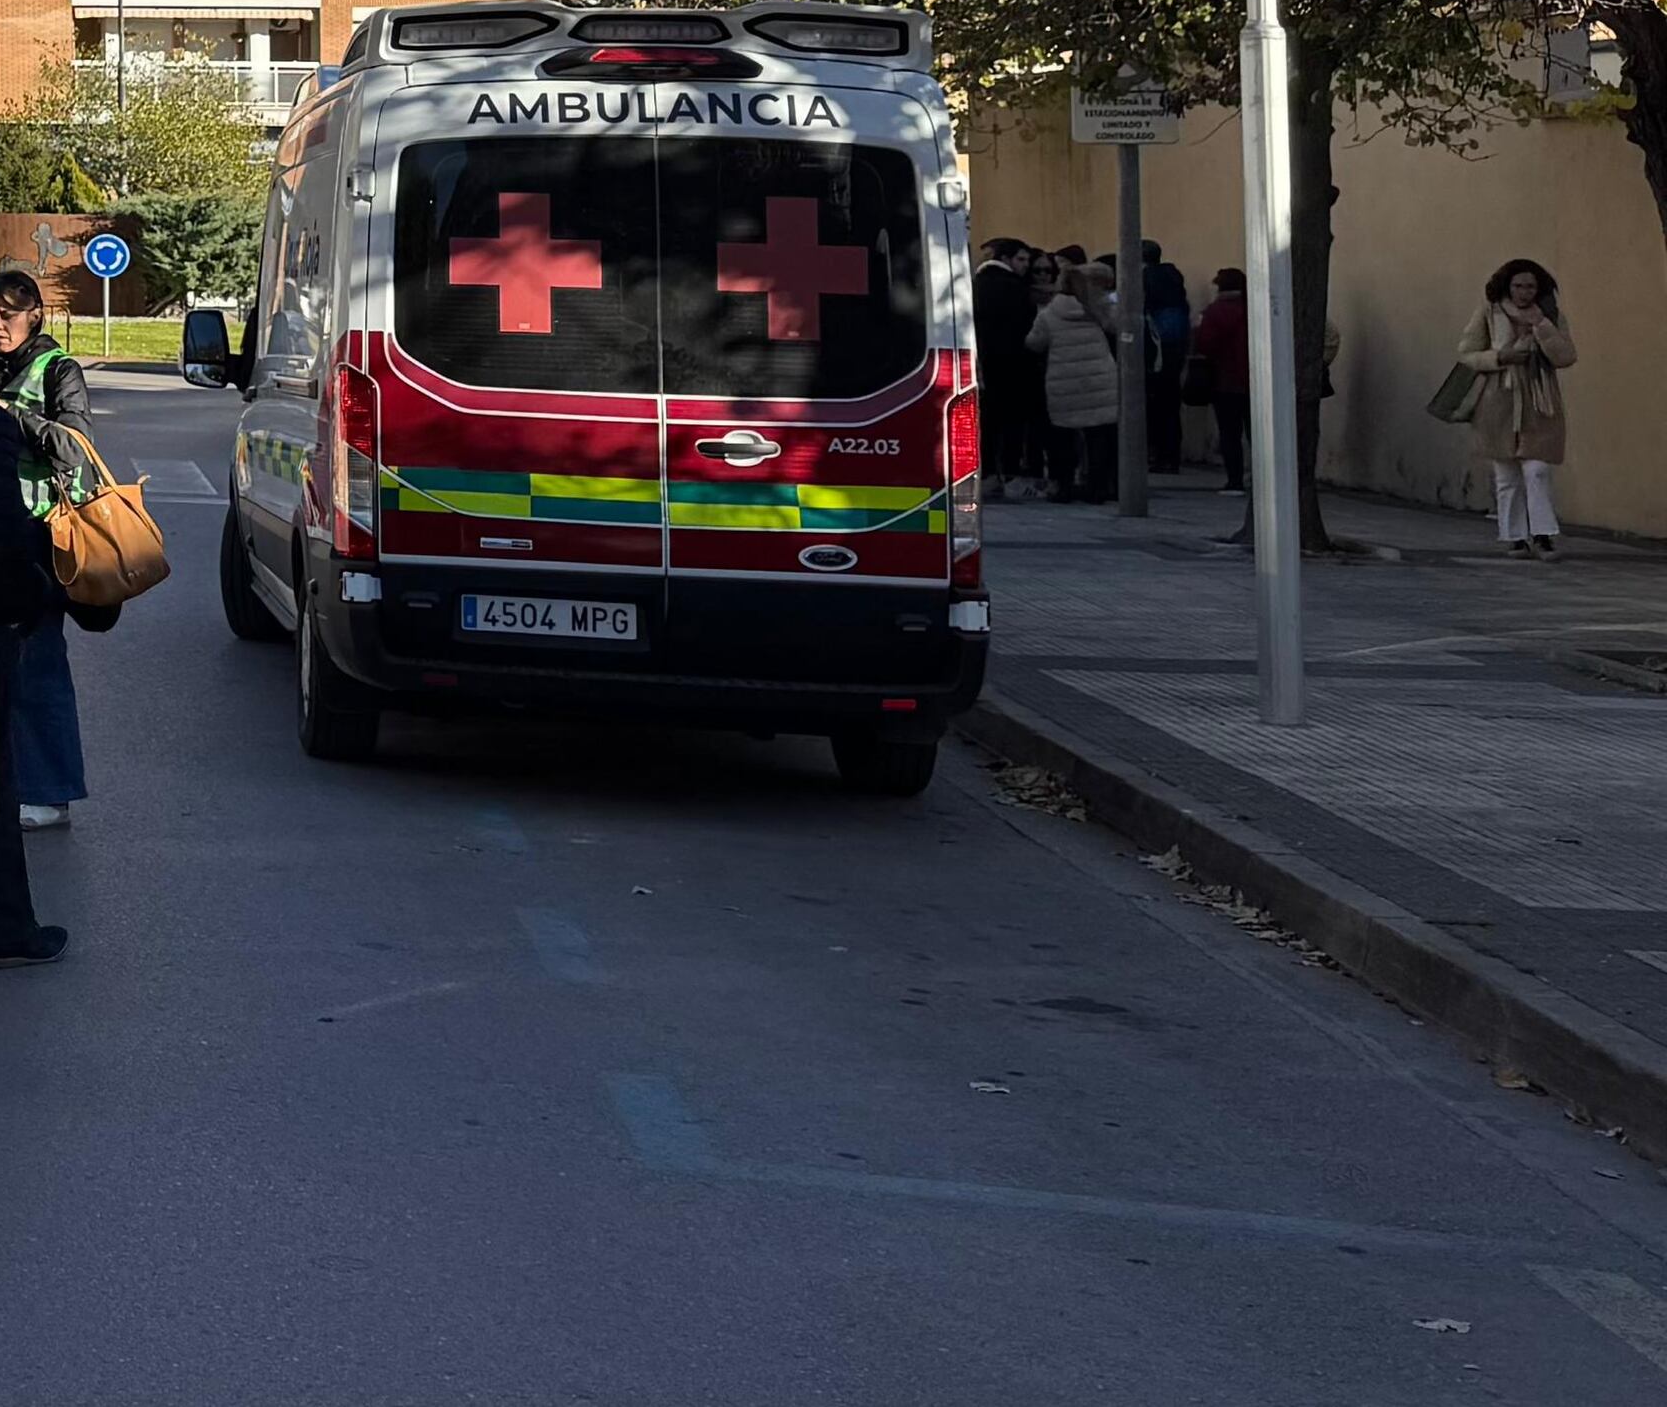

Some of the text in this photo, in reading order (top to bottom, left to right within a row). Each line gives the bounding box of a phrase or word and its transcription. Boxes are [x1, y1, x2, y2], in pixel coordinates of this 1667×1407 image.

[468, 90, 841, 128] AMBULANCIA
[1102, 121, 1142, 129] LIMITADO
[1096, 132, 1155, 140] CONTROLADO
[828, 437, 900, 455] A22.03
[483, 600, 556, 631] 4504
[571, 605, 629, 635] MPG
